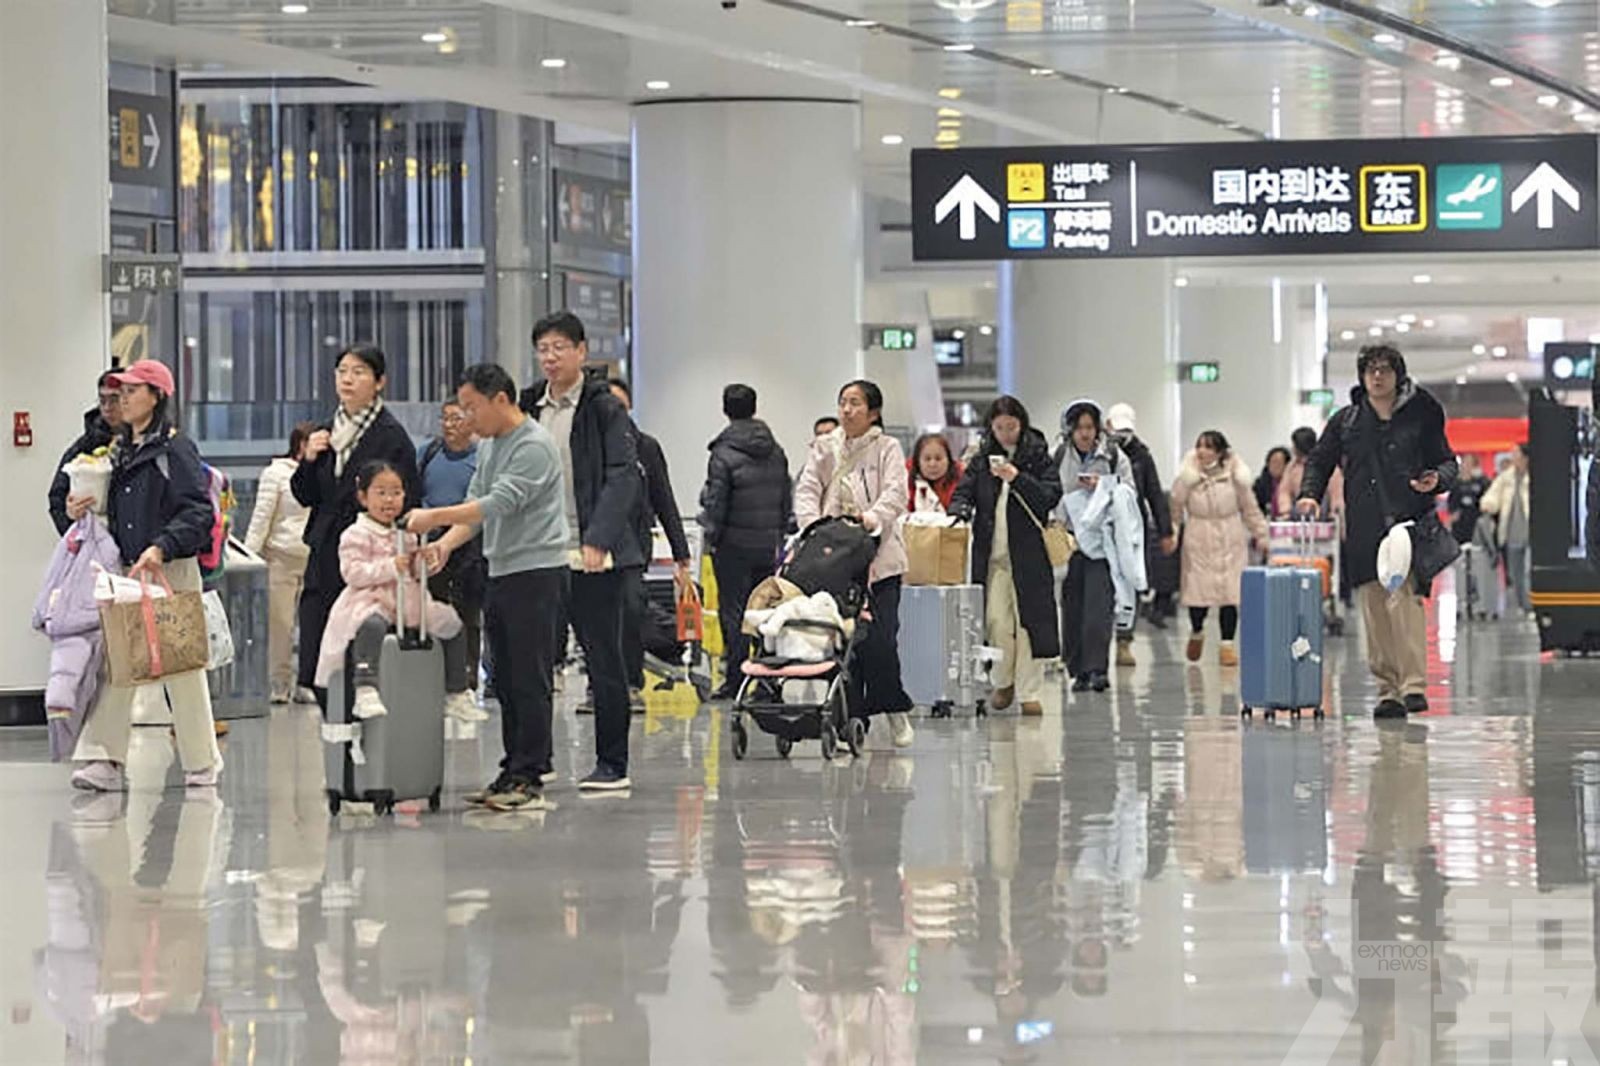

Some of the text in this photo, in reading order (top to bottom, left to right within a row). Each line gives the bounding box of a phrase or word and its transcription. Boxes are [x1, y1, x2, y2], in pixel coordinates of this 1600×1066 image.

[1053, 163, 1110, 183] 出租车
[1212, 166, 1351, 205] 国内到达
[1374, 172, 1412, 208] 东
[1145, 206, 1352, 236] Domestic Arrivals
[1371, 208, 1415, 225] EAST
[1011, 217, 1043, 241] P2
[1054, 232, 1110, 250] Parking
